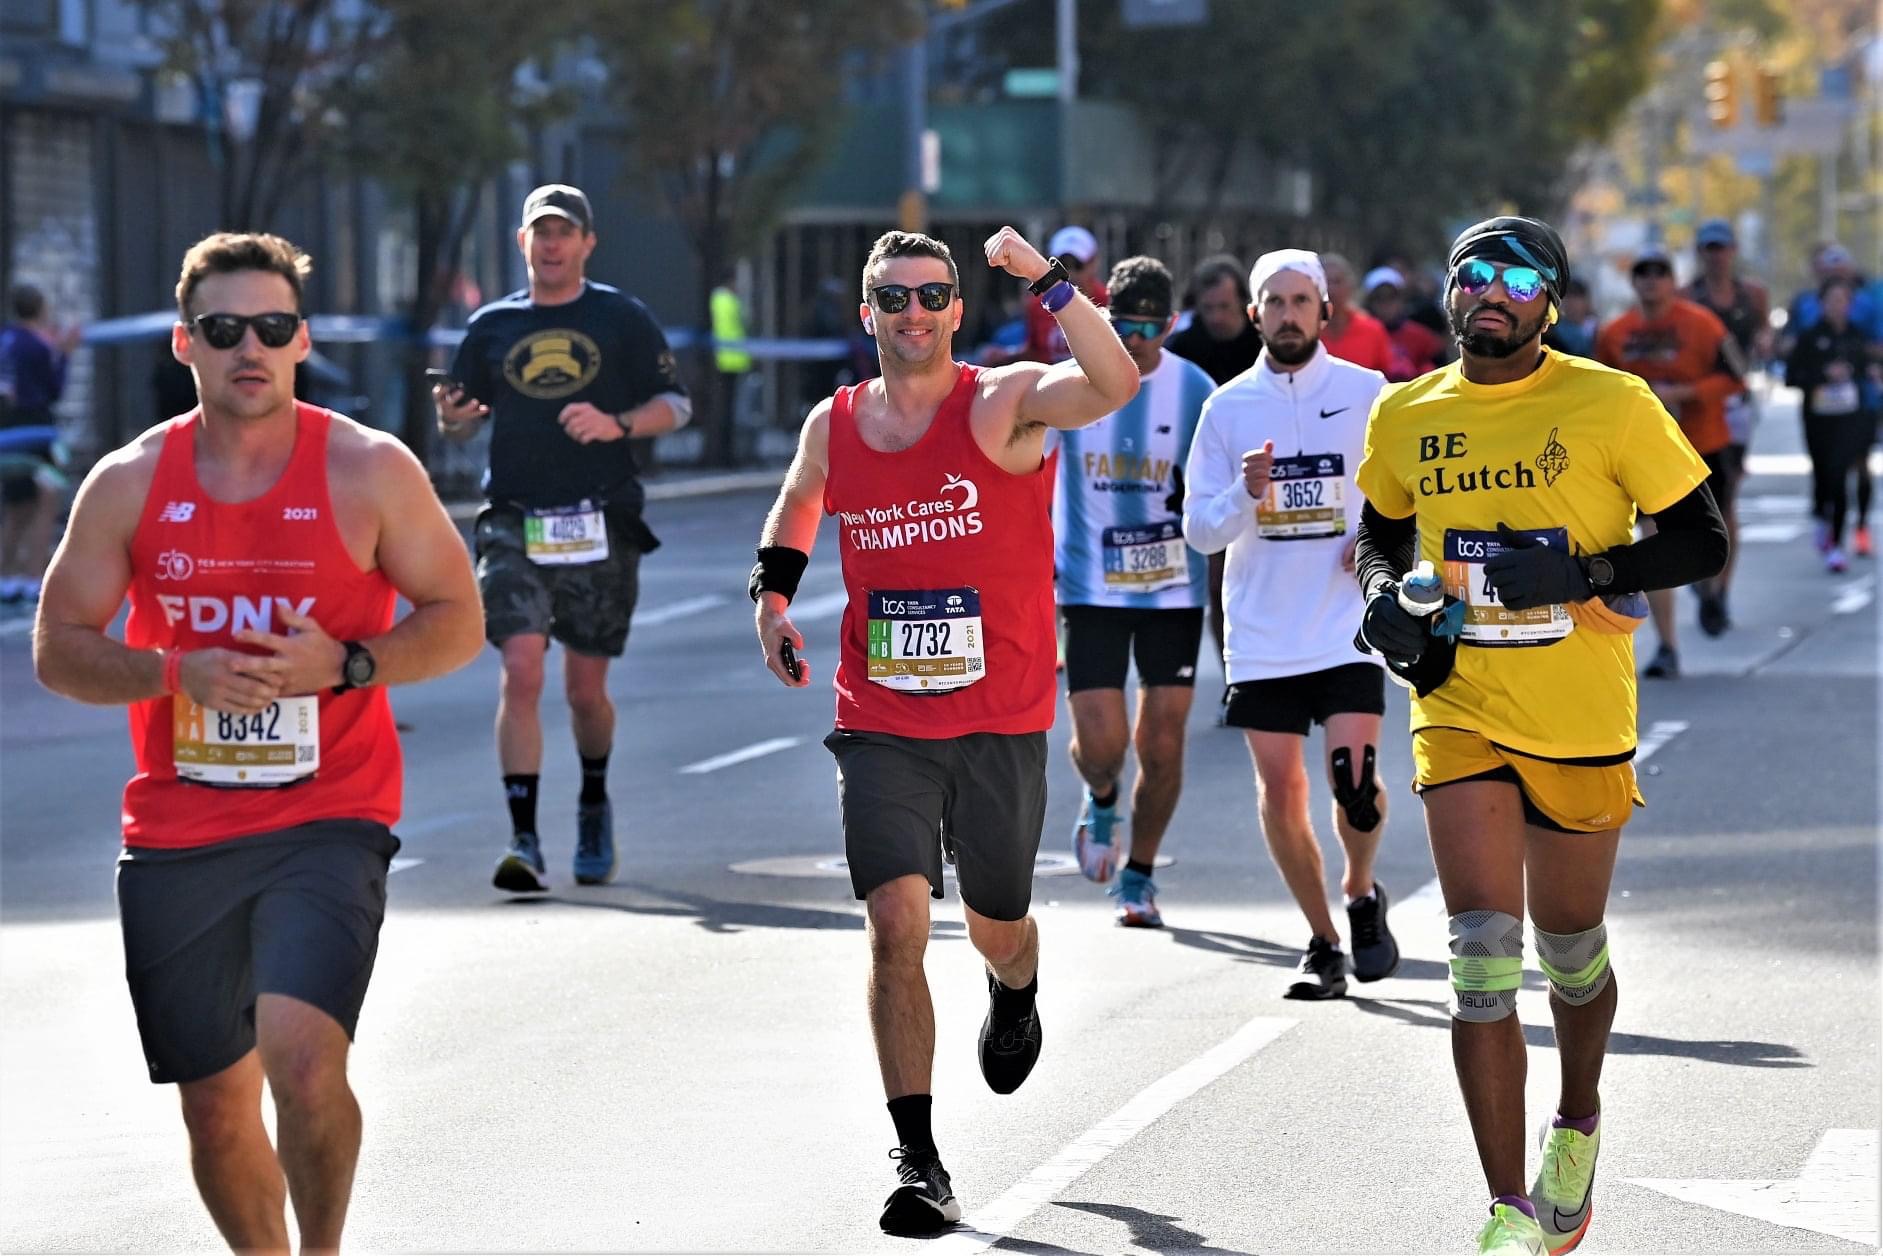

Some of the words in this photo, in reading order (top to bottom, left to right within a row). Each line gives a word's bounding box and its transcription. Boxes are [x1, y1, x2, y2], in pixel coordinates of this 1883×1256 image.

[1419, 432, 1467, 462] BE
[1420, 460, 1536, 496] cLutch
[1283, 480, 1324, 508] 3652
[283, 508, 318, 520] 2021
[840, 511, 865, 526] New
[865, 504, 904, 524] York
[907, 500, 954, 517] Cares
[850, 512, 983, 550] CHAMPIONS
[1458, 537, 1484, 557] tcs
[198, 559, 215, 568] TCS
[156, 594, 317, 638] FDNY
[882, 597, 905, 614] tcs
[881, 642, 888, 658] B
[902, 622, 952, 657] 2732
[966, 625, 975, 649] 2021
[218, 702, 281, 741] 8342
